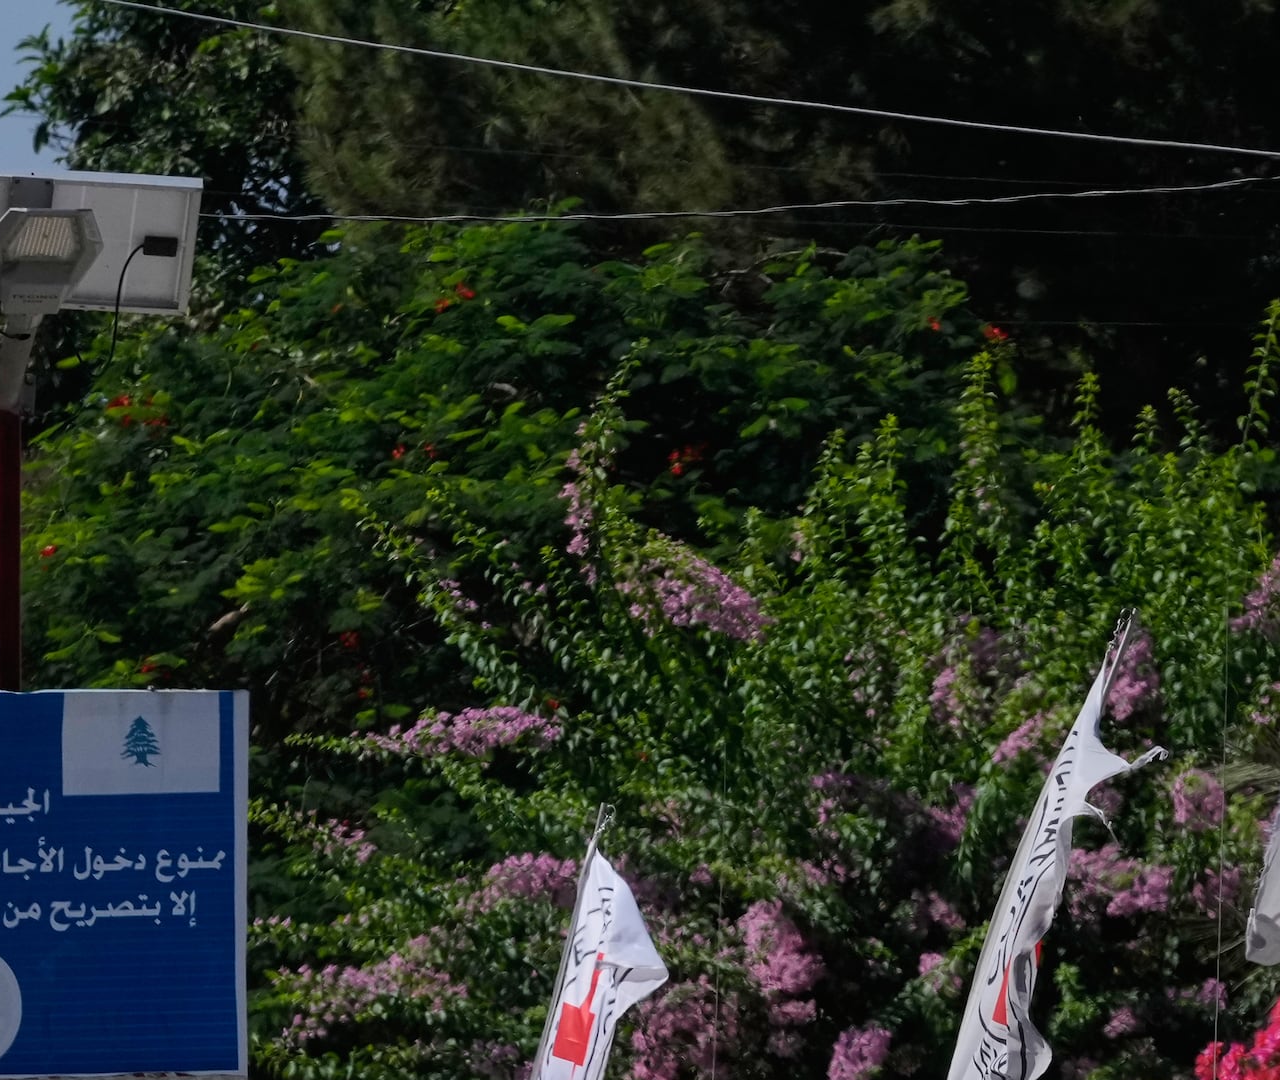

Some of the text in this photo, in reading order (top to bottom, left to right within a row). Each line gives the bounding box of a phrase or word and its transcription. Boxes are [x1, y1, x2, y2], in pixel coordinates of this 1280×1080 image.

[73, 845, 146, 881] دخول
[154, 847, 226, 883] ممنوع
[3, 901, 40, 929] من
[50, 896, 161, 931] بتصريح
[170, 890, 197, 928] إلا
